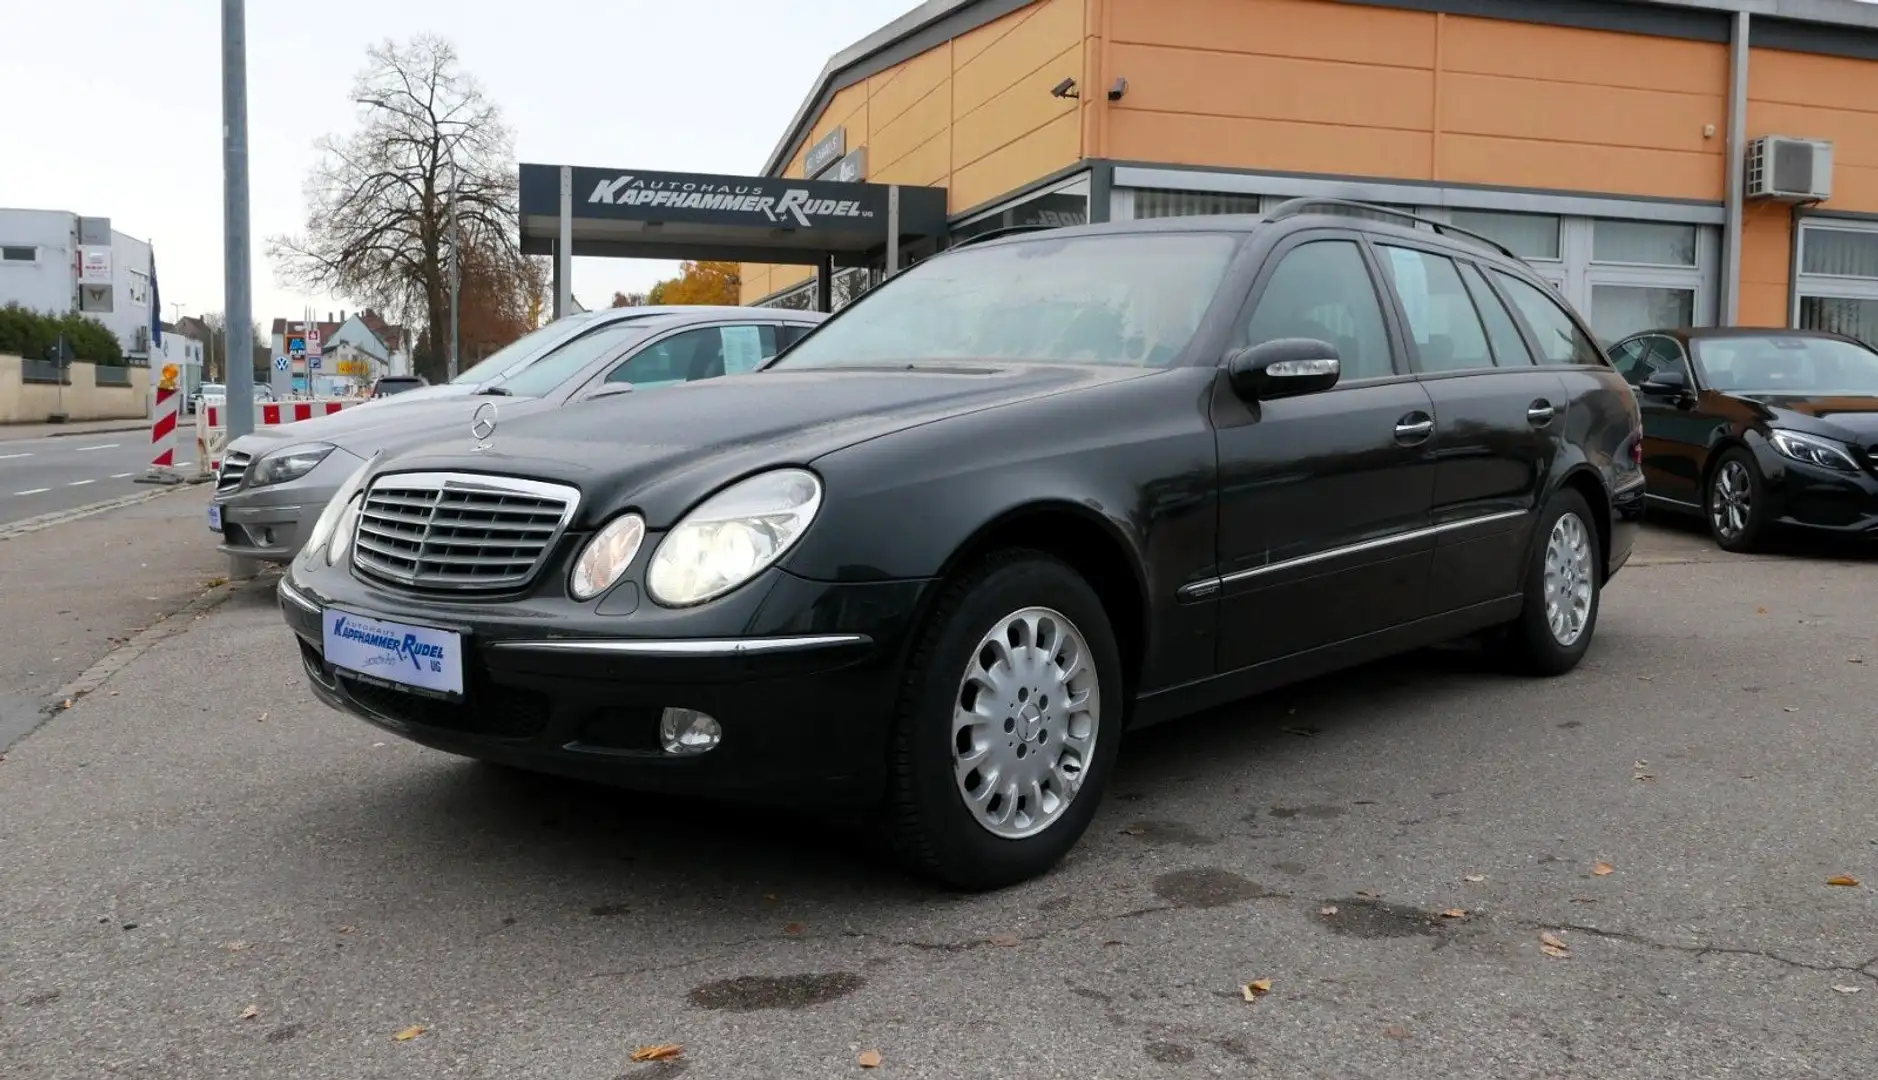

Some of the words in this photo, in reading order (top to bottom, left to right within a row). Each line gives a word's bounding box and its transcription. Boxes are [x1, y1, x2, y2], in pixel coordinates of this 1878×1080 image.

[631, 179, 763, 195] AUTOHAUS
[588, 175, 777, 222] KAPFHAMMER
[775, 188, 861, 227] RUDEL
[345, 620, 395, 637] AUTOHAUS
[333, 616, 403, 662] KAPFHAMMER
[401, 633, 443, 671] RUDEL
[430, 659, 442, 673] UG
